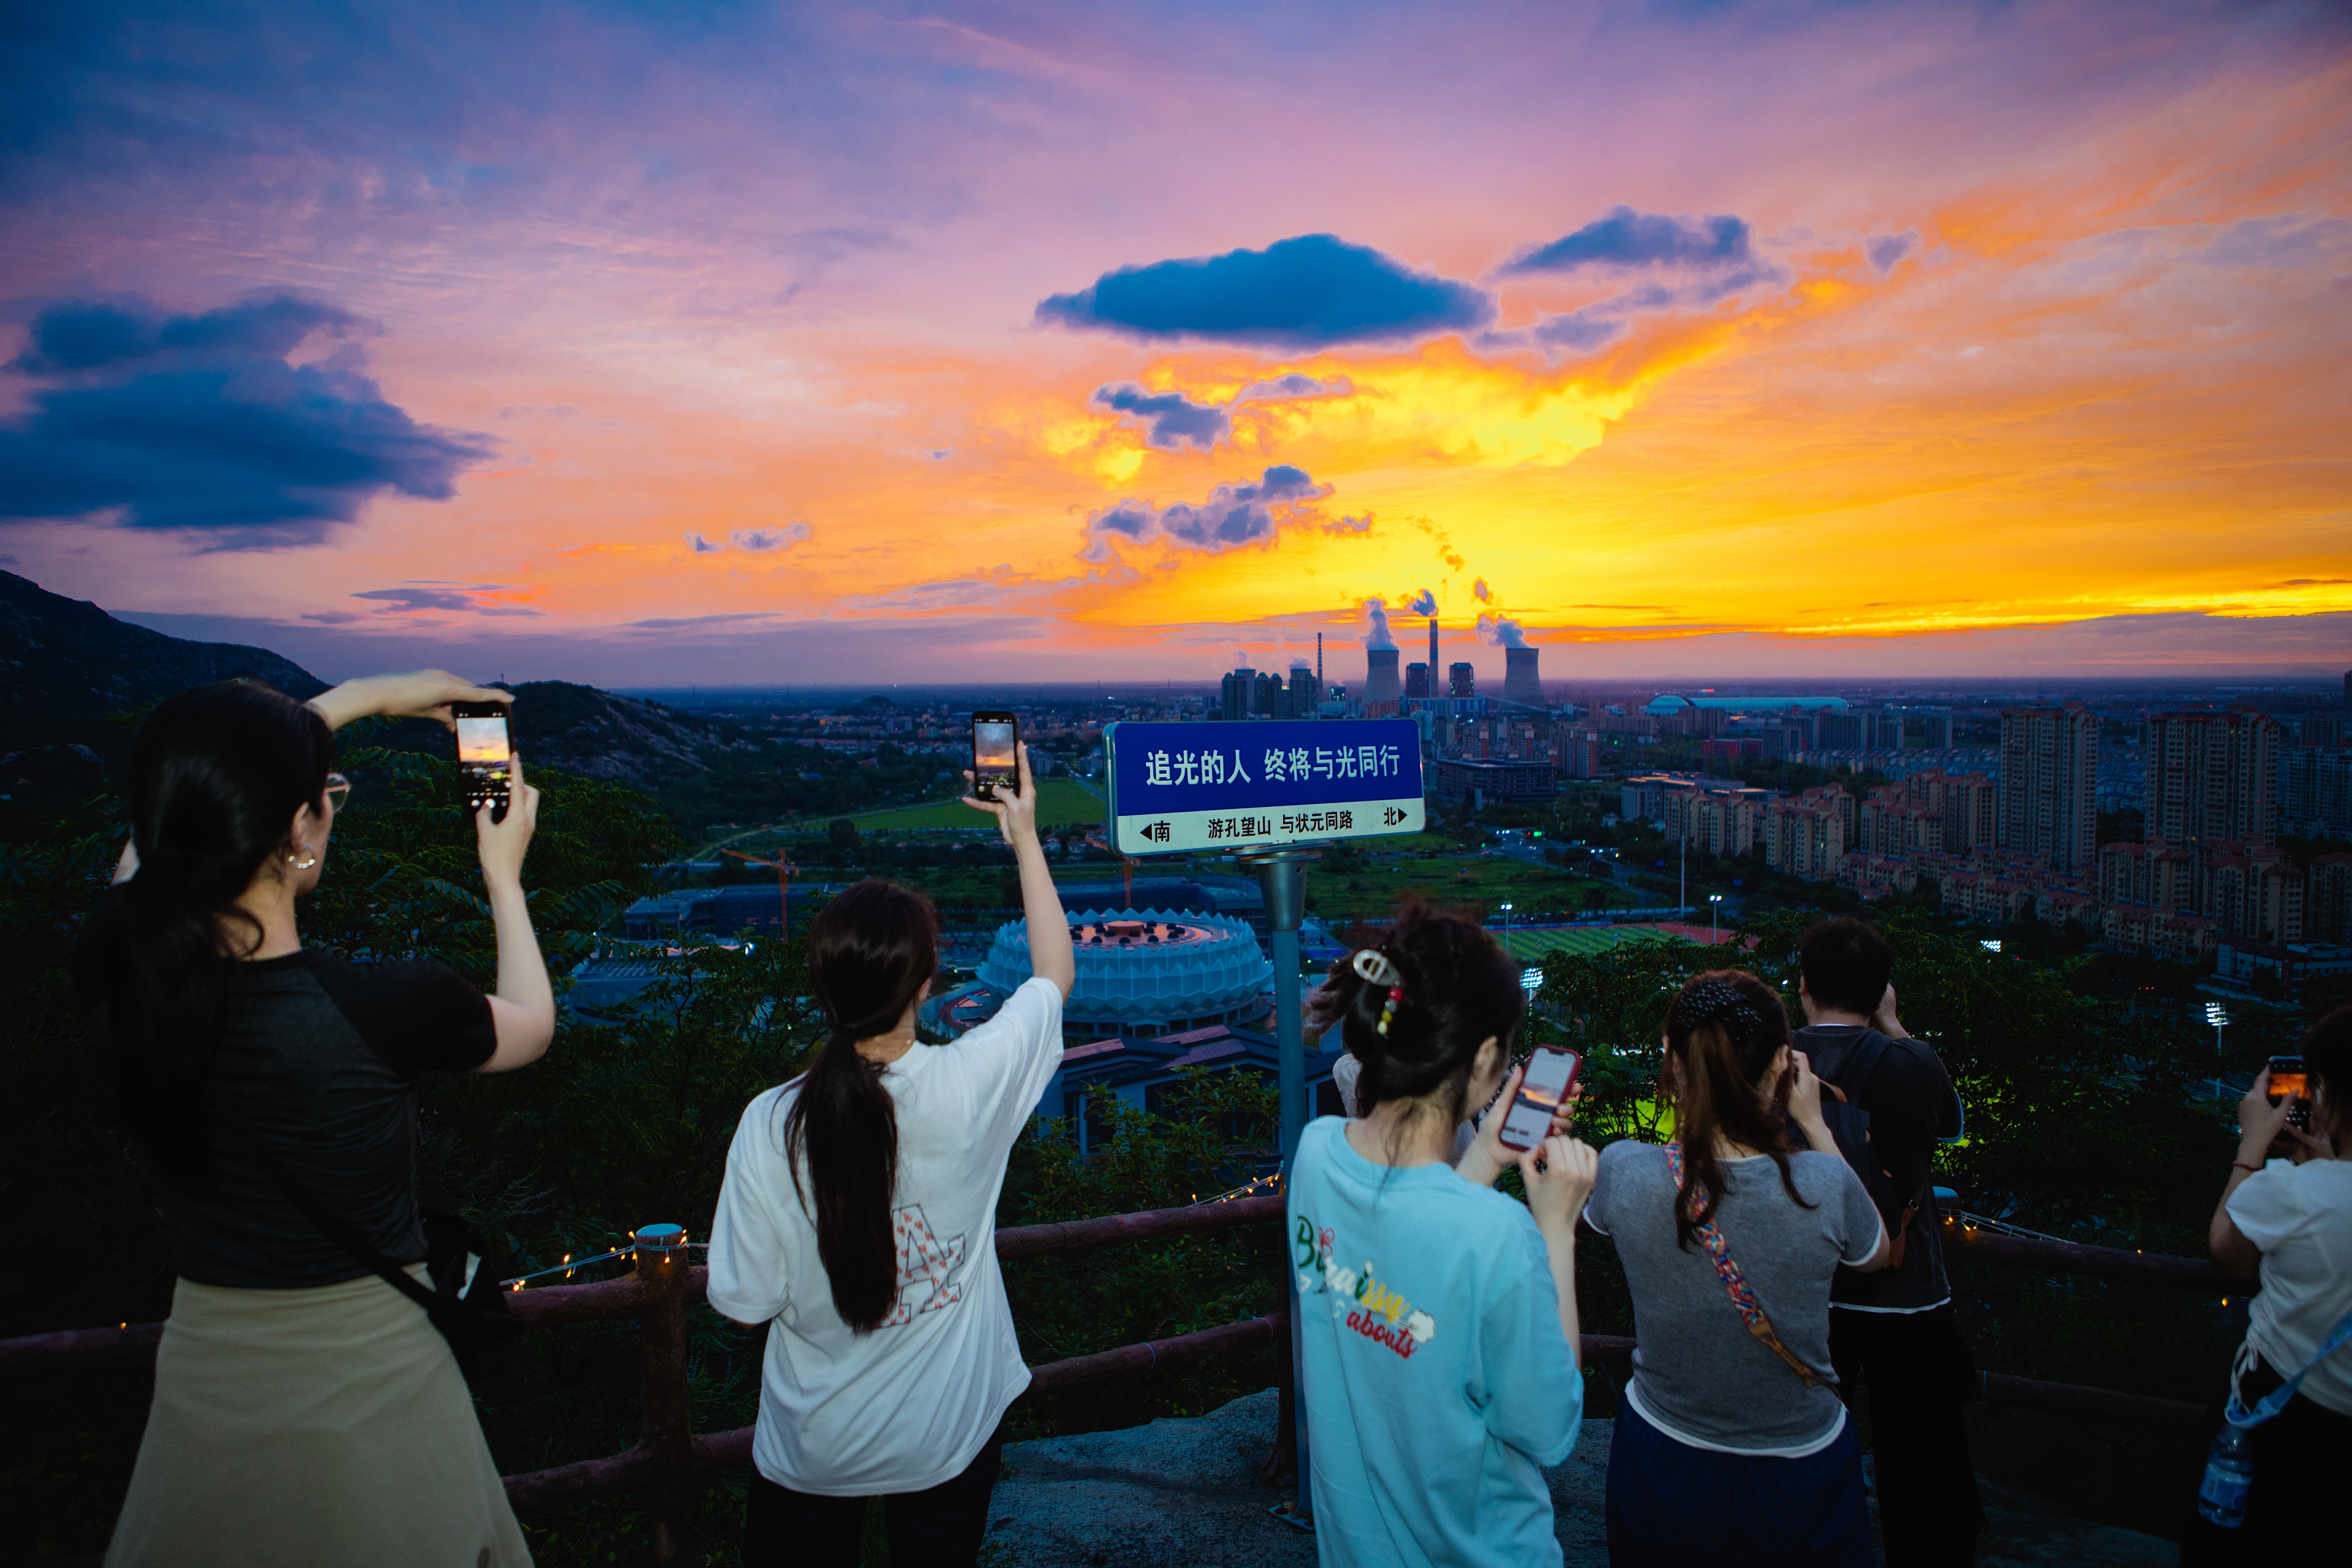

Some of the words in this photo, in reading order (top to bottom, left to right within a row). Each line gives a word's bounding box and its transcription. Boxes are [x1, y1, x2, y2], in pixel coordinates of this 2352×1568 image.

[1145, 749, 1251, 786] 追光的人
[1264, 744, 1400, 782] 终将与光同行
[1154, 821, 1170, 843] 南
[1208, 815, 1271, 839] 游孔望山
[1280, 810, 1353, 834] 与状元同路
[1384, 807, 1397, 827] 北
